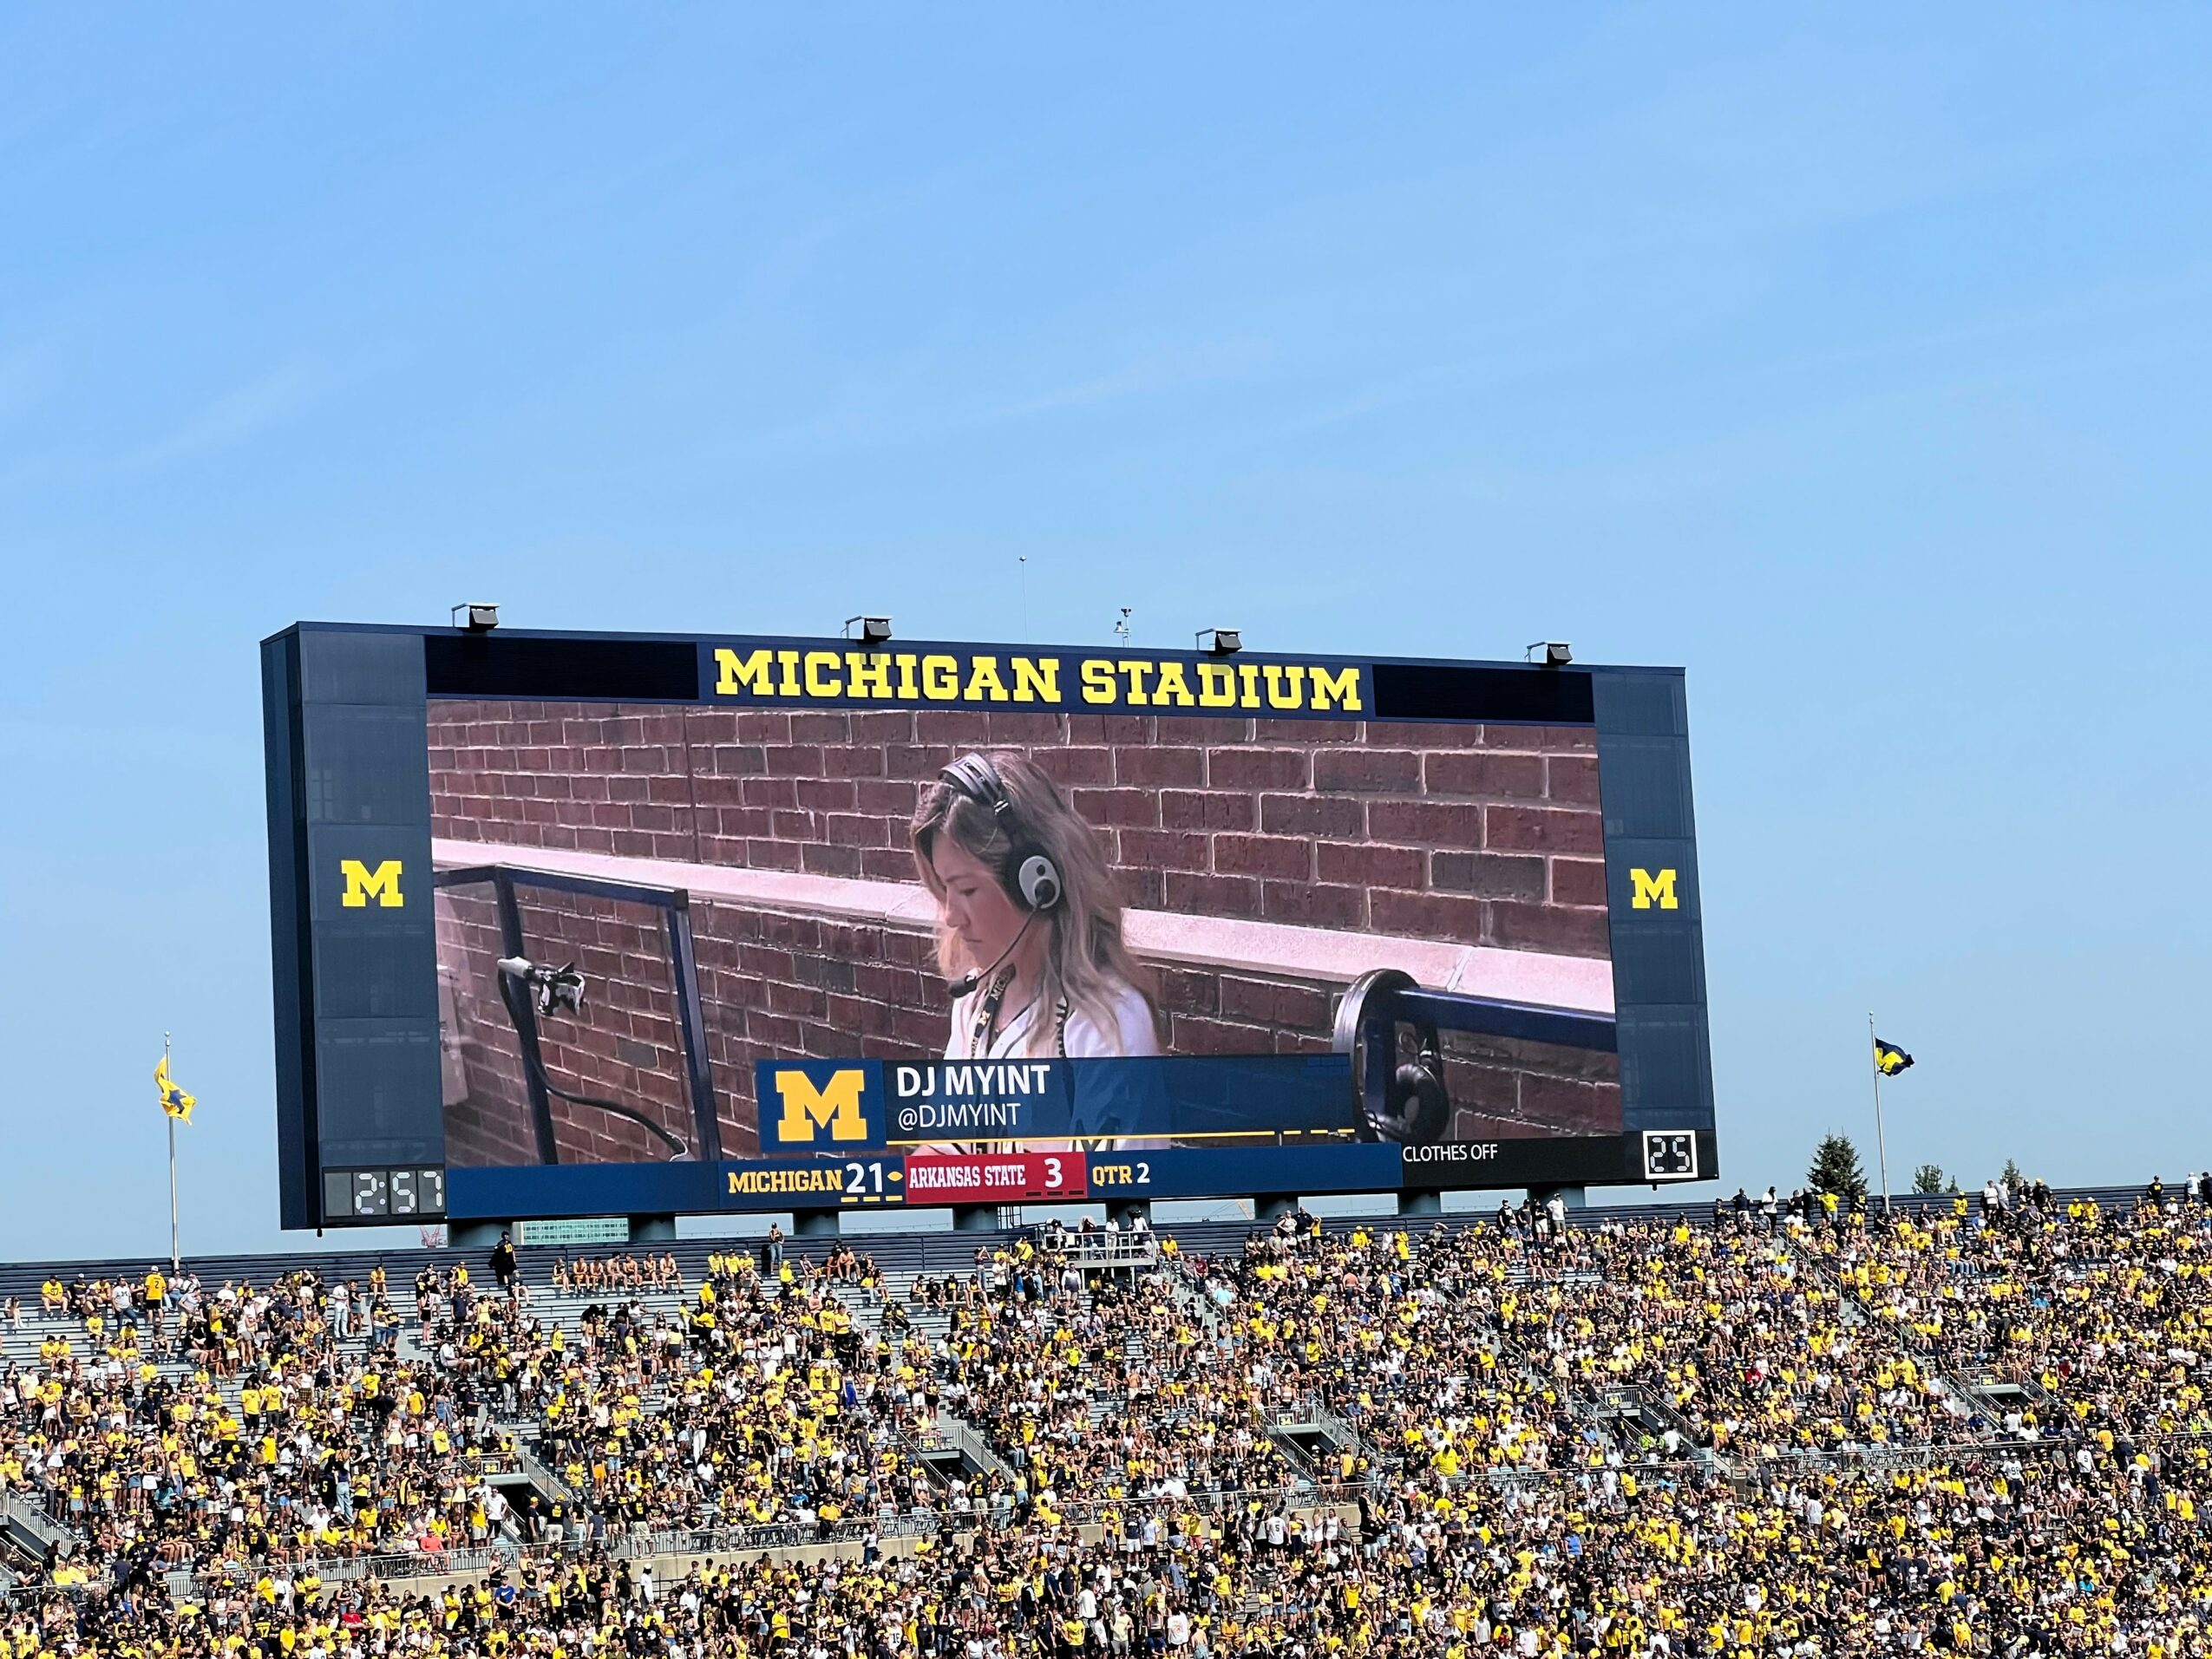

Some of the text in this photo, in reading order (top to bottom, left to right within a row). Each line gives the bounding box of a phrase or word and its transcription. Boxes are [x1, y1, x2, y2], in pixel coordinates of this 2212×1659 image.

[716, 649, 1362, 711] MICHIGAN STADIUM
[342, 859, 404, 907] M
[1631, 868, 1679, 910] M
[896, 1064, 1050, 1097] DJ MYINT
[776, 1069, 867, 1141] M
[898, 1102, 1021, 1131] @DJMYINT
[1402, 1143, 1499, 1163] CLOTHES OFF
[1649, 1135, 1691, 1172] 25
[727, 1162, 883, 1194] MICHIGAN 21
[908, 1158, 1063, 1189] ARKANSAS STATE 3
[1092, 1162, 1151, 1185] QTR 2
[355, 1172, 442, 1214] 2:57
[154, 1280, 160, 1290] 2
[322, 1480, 329, 1492] 5
[1274, 1524, 1280, 1532] 5
[256, 1626, 270, 1638] 17
